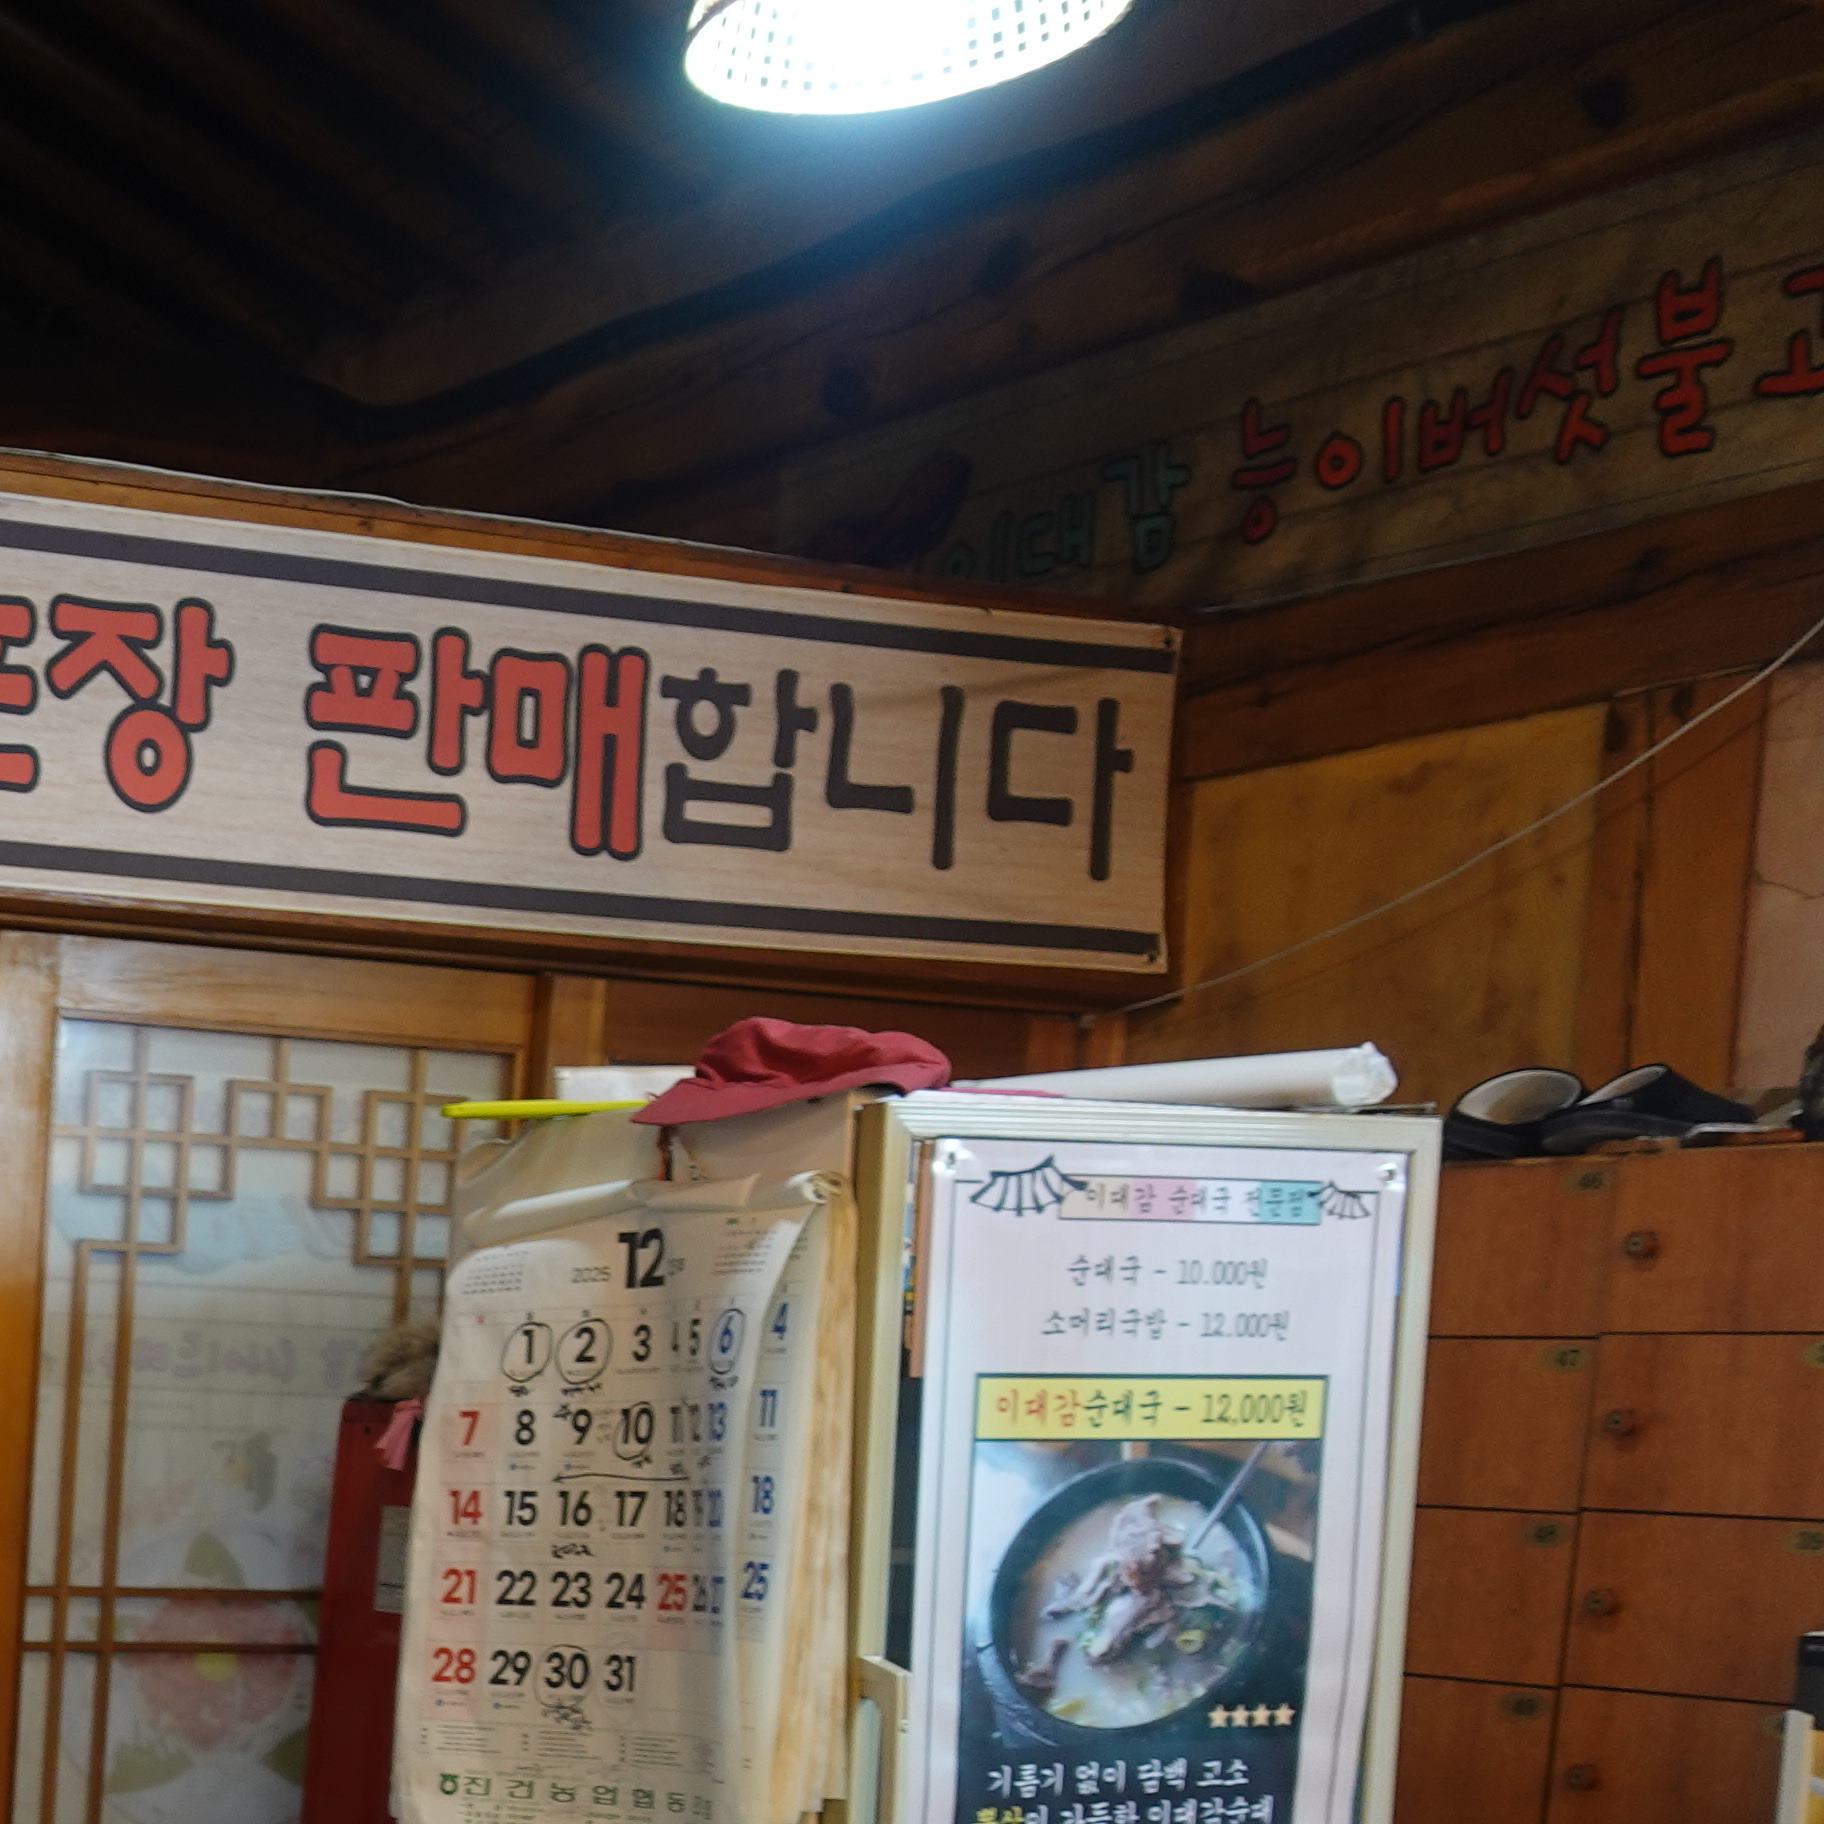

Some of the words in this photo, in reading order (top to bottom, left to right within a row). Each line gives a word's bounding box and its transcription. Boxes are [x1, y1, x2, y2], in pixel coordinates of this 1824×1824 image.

[303, 624, 1136, 883] 판매합니다
[570, 1266, 612, 1285] 2025
[617, 1227, 667, 1290] 12
[1067, 1253, 1143, 1289] 순대국
[522, 1328, 535, 1365] 1
[574, 1327, 596, 1364] 2
[632, 1324, 652, 1363] 3
[718, 1313, 733, 1354] 6
[1041, 1307, 1169, 1342] 소머리국밥
[458, 1410, 480, 1446] 7
[514, 1409, 536, 1446] 8
[570, 1408, 593, 1446] 9
[619, 1406, 655, 1446] 10
[995, 1388, 1164, 1430] 이대감순대국
[448, 1489, 482, 1526] 14
[504, 1489, 539, 1527] 15
[558, 1489, 594, 1528] 16
[615, 1490, 649, 1528] 17
[663, 1489, 688, 1528] 18
[751, 1474, 775, 1515] 18
[440, 1567, 478, 1605] 21
[495, 1569, 538, 1607] 22
[550, 1571, 594, 1609] 23
[605, 1571, 647, 1611] 24
[656, 1572, 689, 1612] 25
[741, 1560, 770, 1601] 25
[431, 1647, 477, 1685] 28
[488, 1649, 532, 1687] 29
[544, 1651, 591, 1690] 30
[604, 1653, 637, 1693] 31
[988, 1761, 1065, 1800] 기름기
[1075, 1759, 1127, 1796] 없이
[1136, 1756, 1189, 1794] 담백
[1196, 1757, 1251, 1787] 고소
